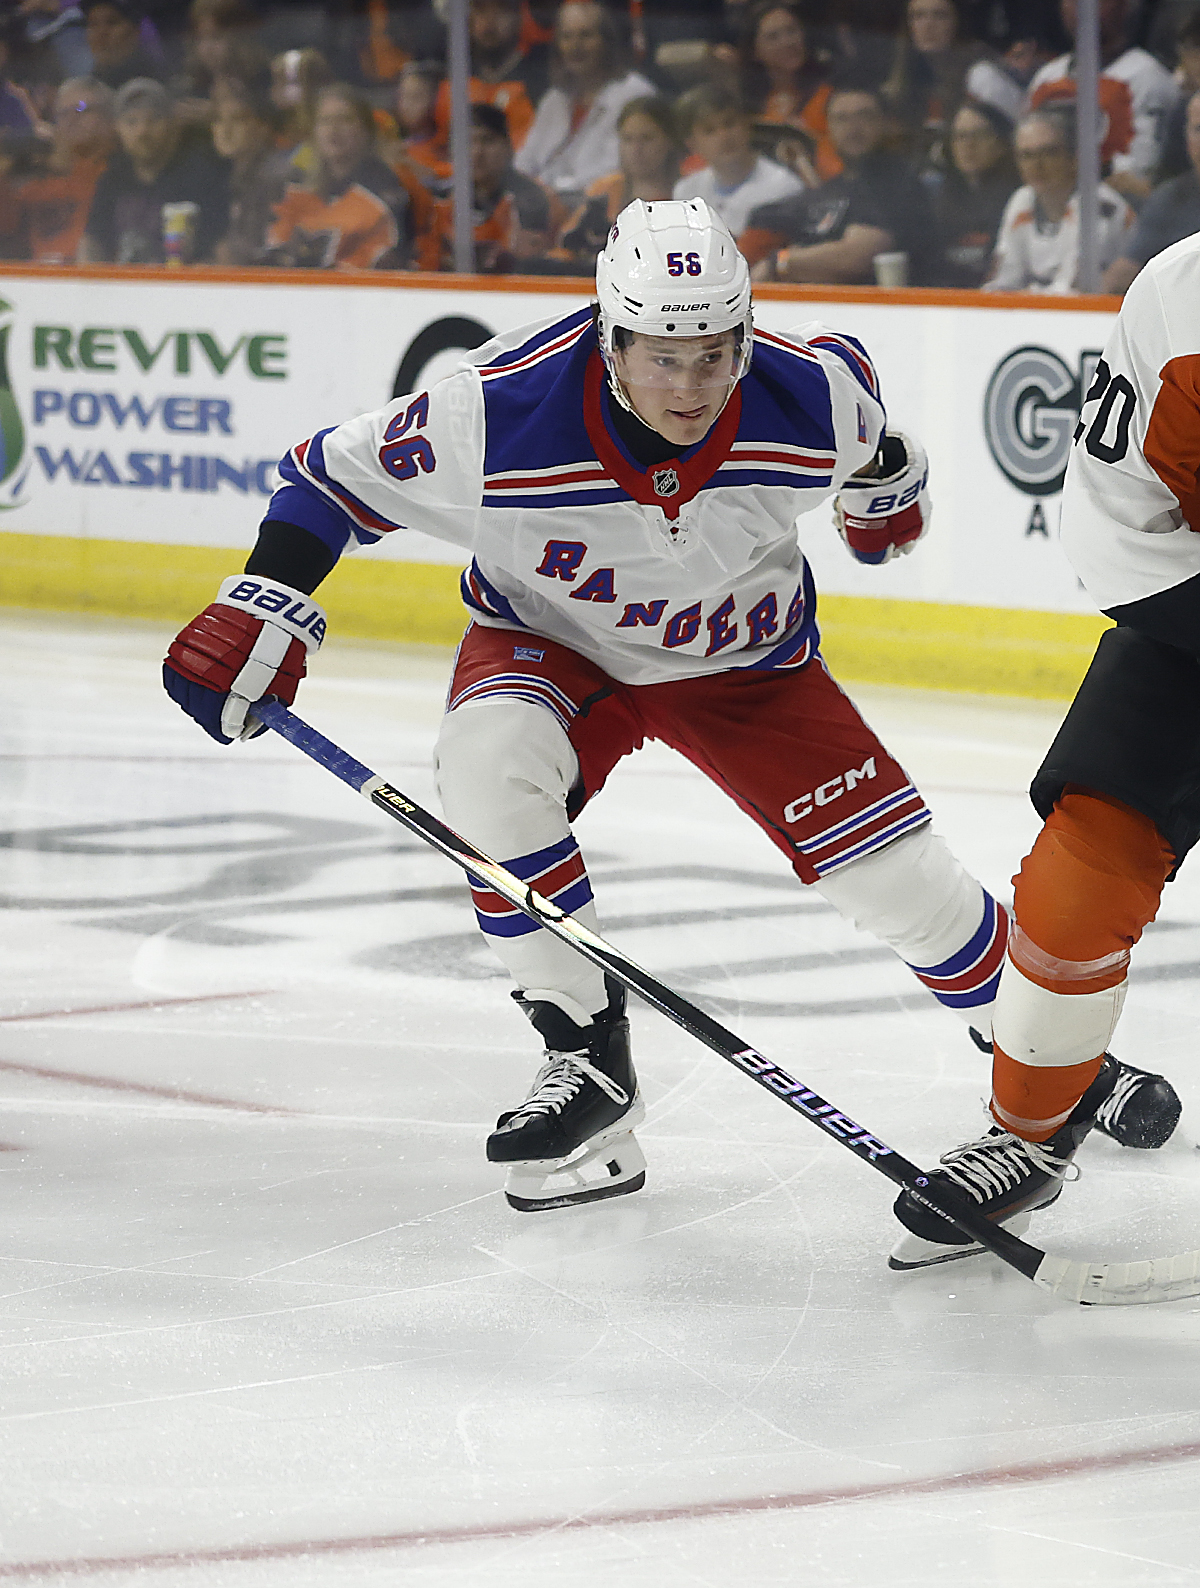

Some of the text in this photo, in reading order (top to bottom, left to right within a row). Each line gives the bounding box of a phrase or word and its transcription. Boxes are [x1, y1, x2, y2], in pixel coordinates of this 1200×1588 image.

[666, 252, 702, 276] 56
[660, 303, 711, 312] BAUER
[33, 326, 287, 378] REVIVE
[34, 390, 232, 434] POWER
[379, 391, 437, 482] 56
[783, 756, 878, 824] CCM
[731, 1048, 894, 1161] BAUER
